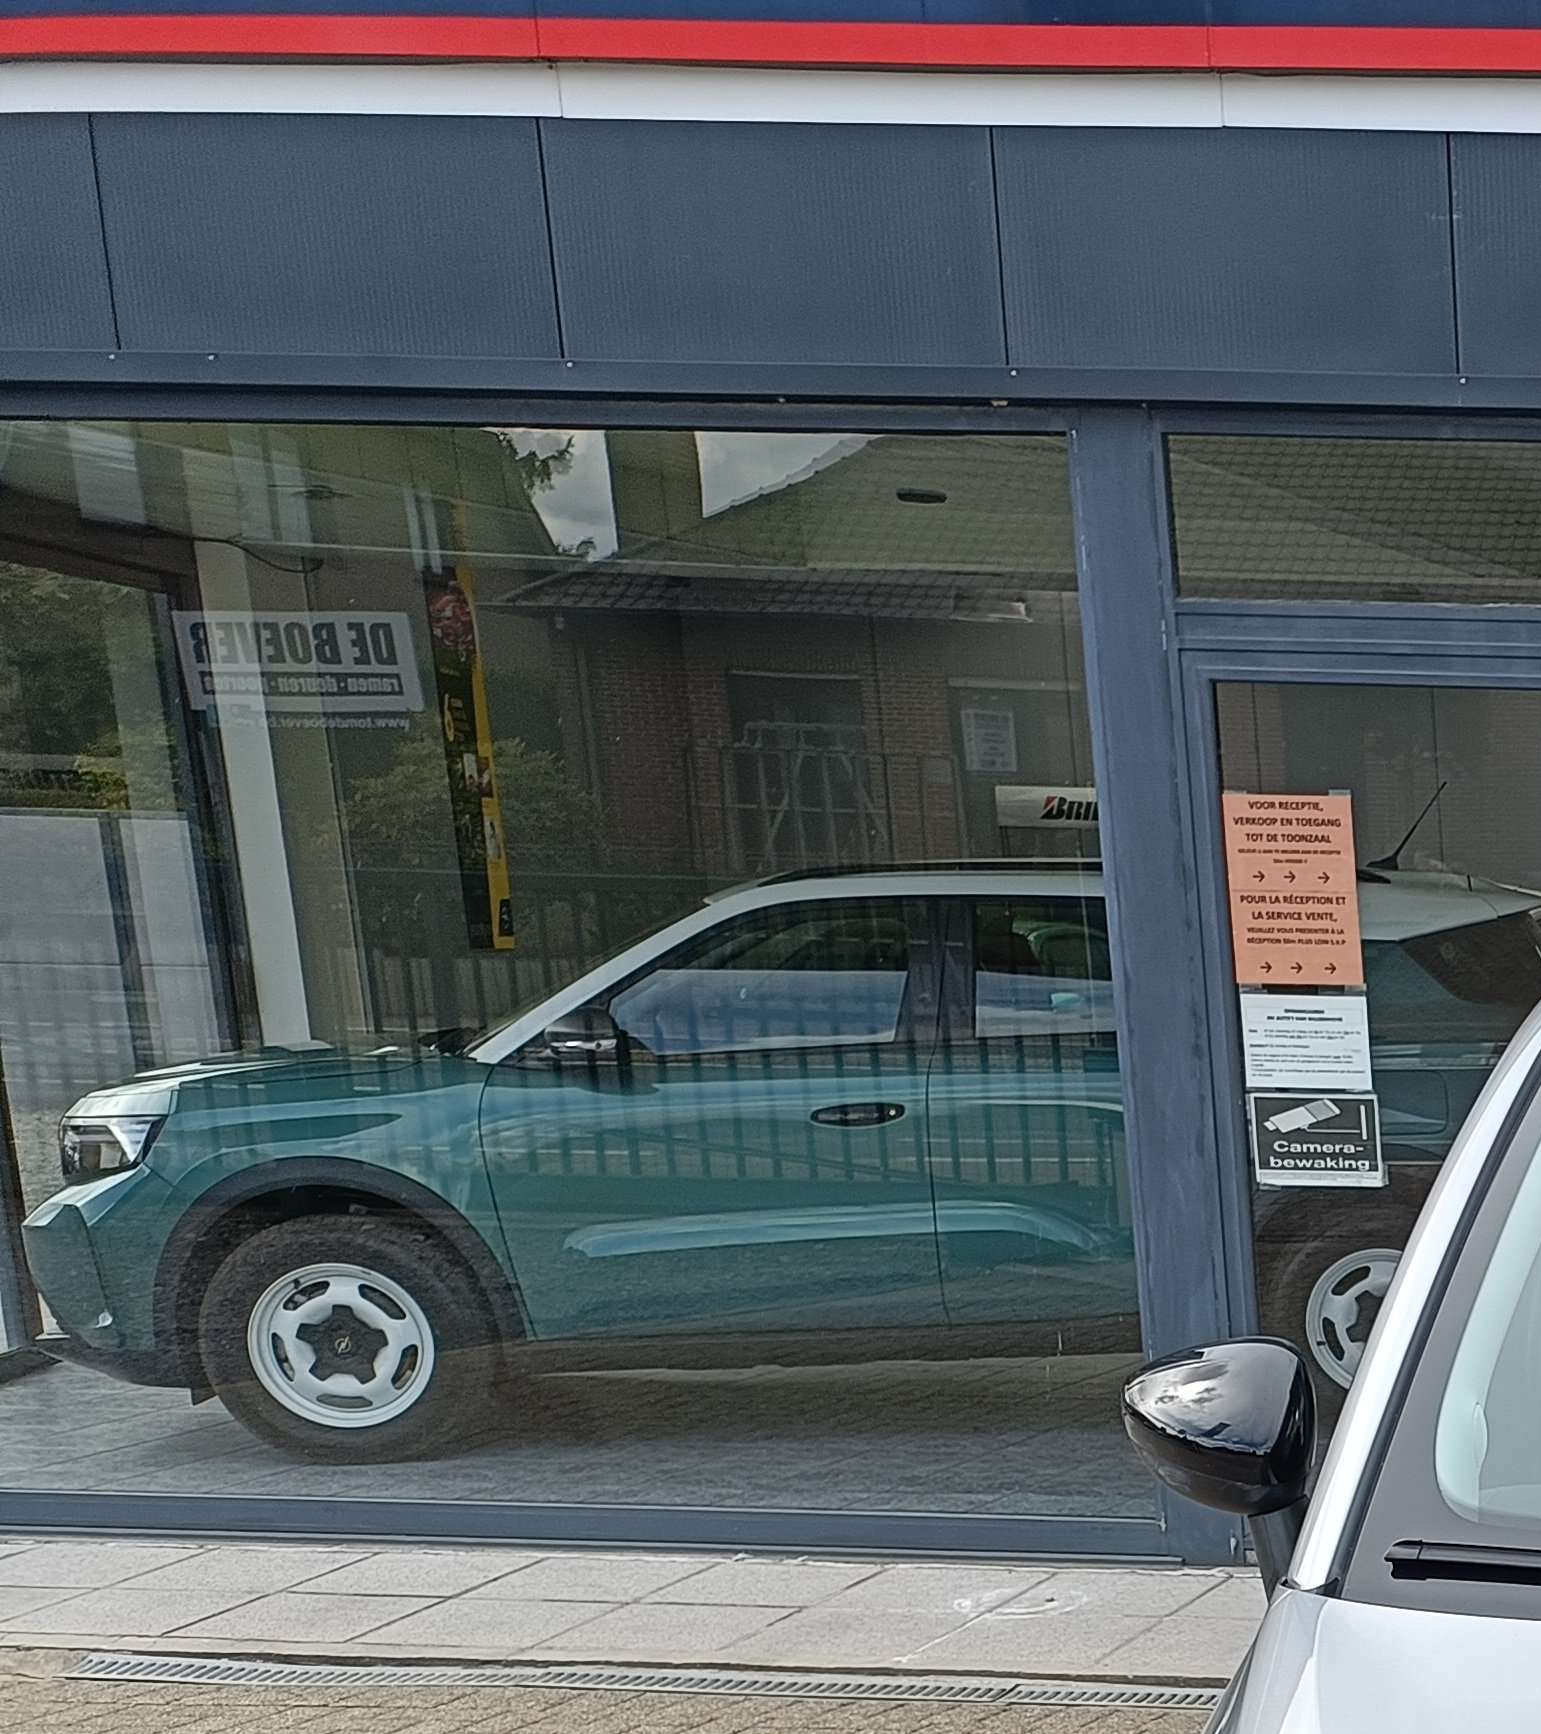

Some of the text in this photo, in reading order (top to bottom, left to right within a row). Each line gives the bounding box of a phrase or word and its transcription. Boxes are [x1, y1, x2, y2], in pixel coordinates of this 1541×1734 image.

[1248, 801, 1277, 810] VOOR
[1233, 817, 1342, 827] VERKOOP EN TOEGANG
[1245, 833, 1332, 843] TOT DE TOONZAAL
[1240, 894, 1347, 906] POUR LA RÉCEPTION ET
[1252, 911, 1338, 923] LA SERVICE VENTE,
[1272, 1140, 1365, 1154] Camera-
[1269, 1155, 1370, 1171] bewaking
